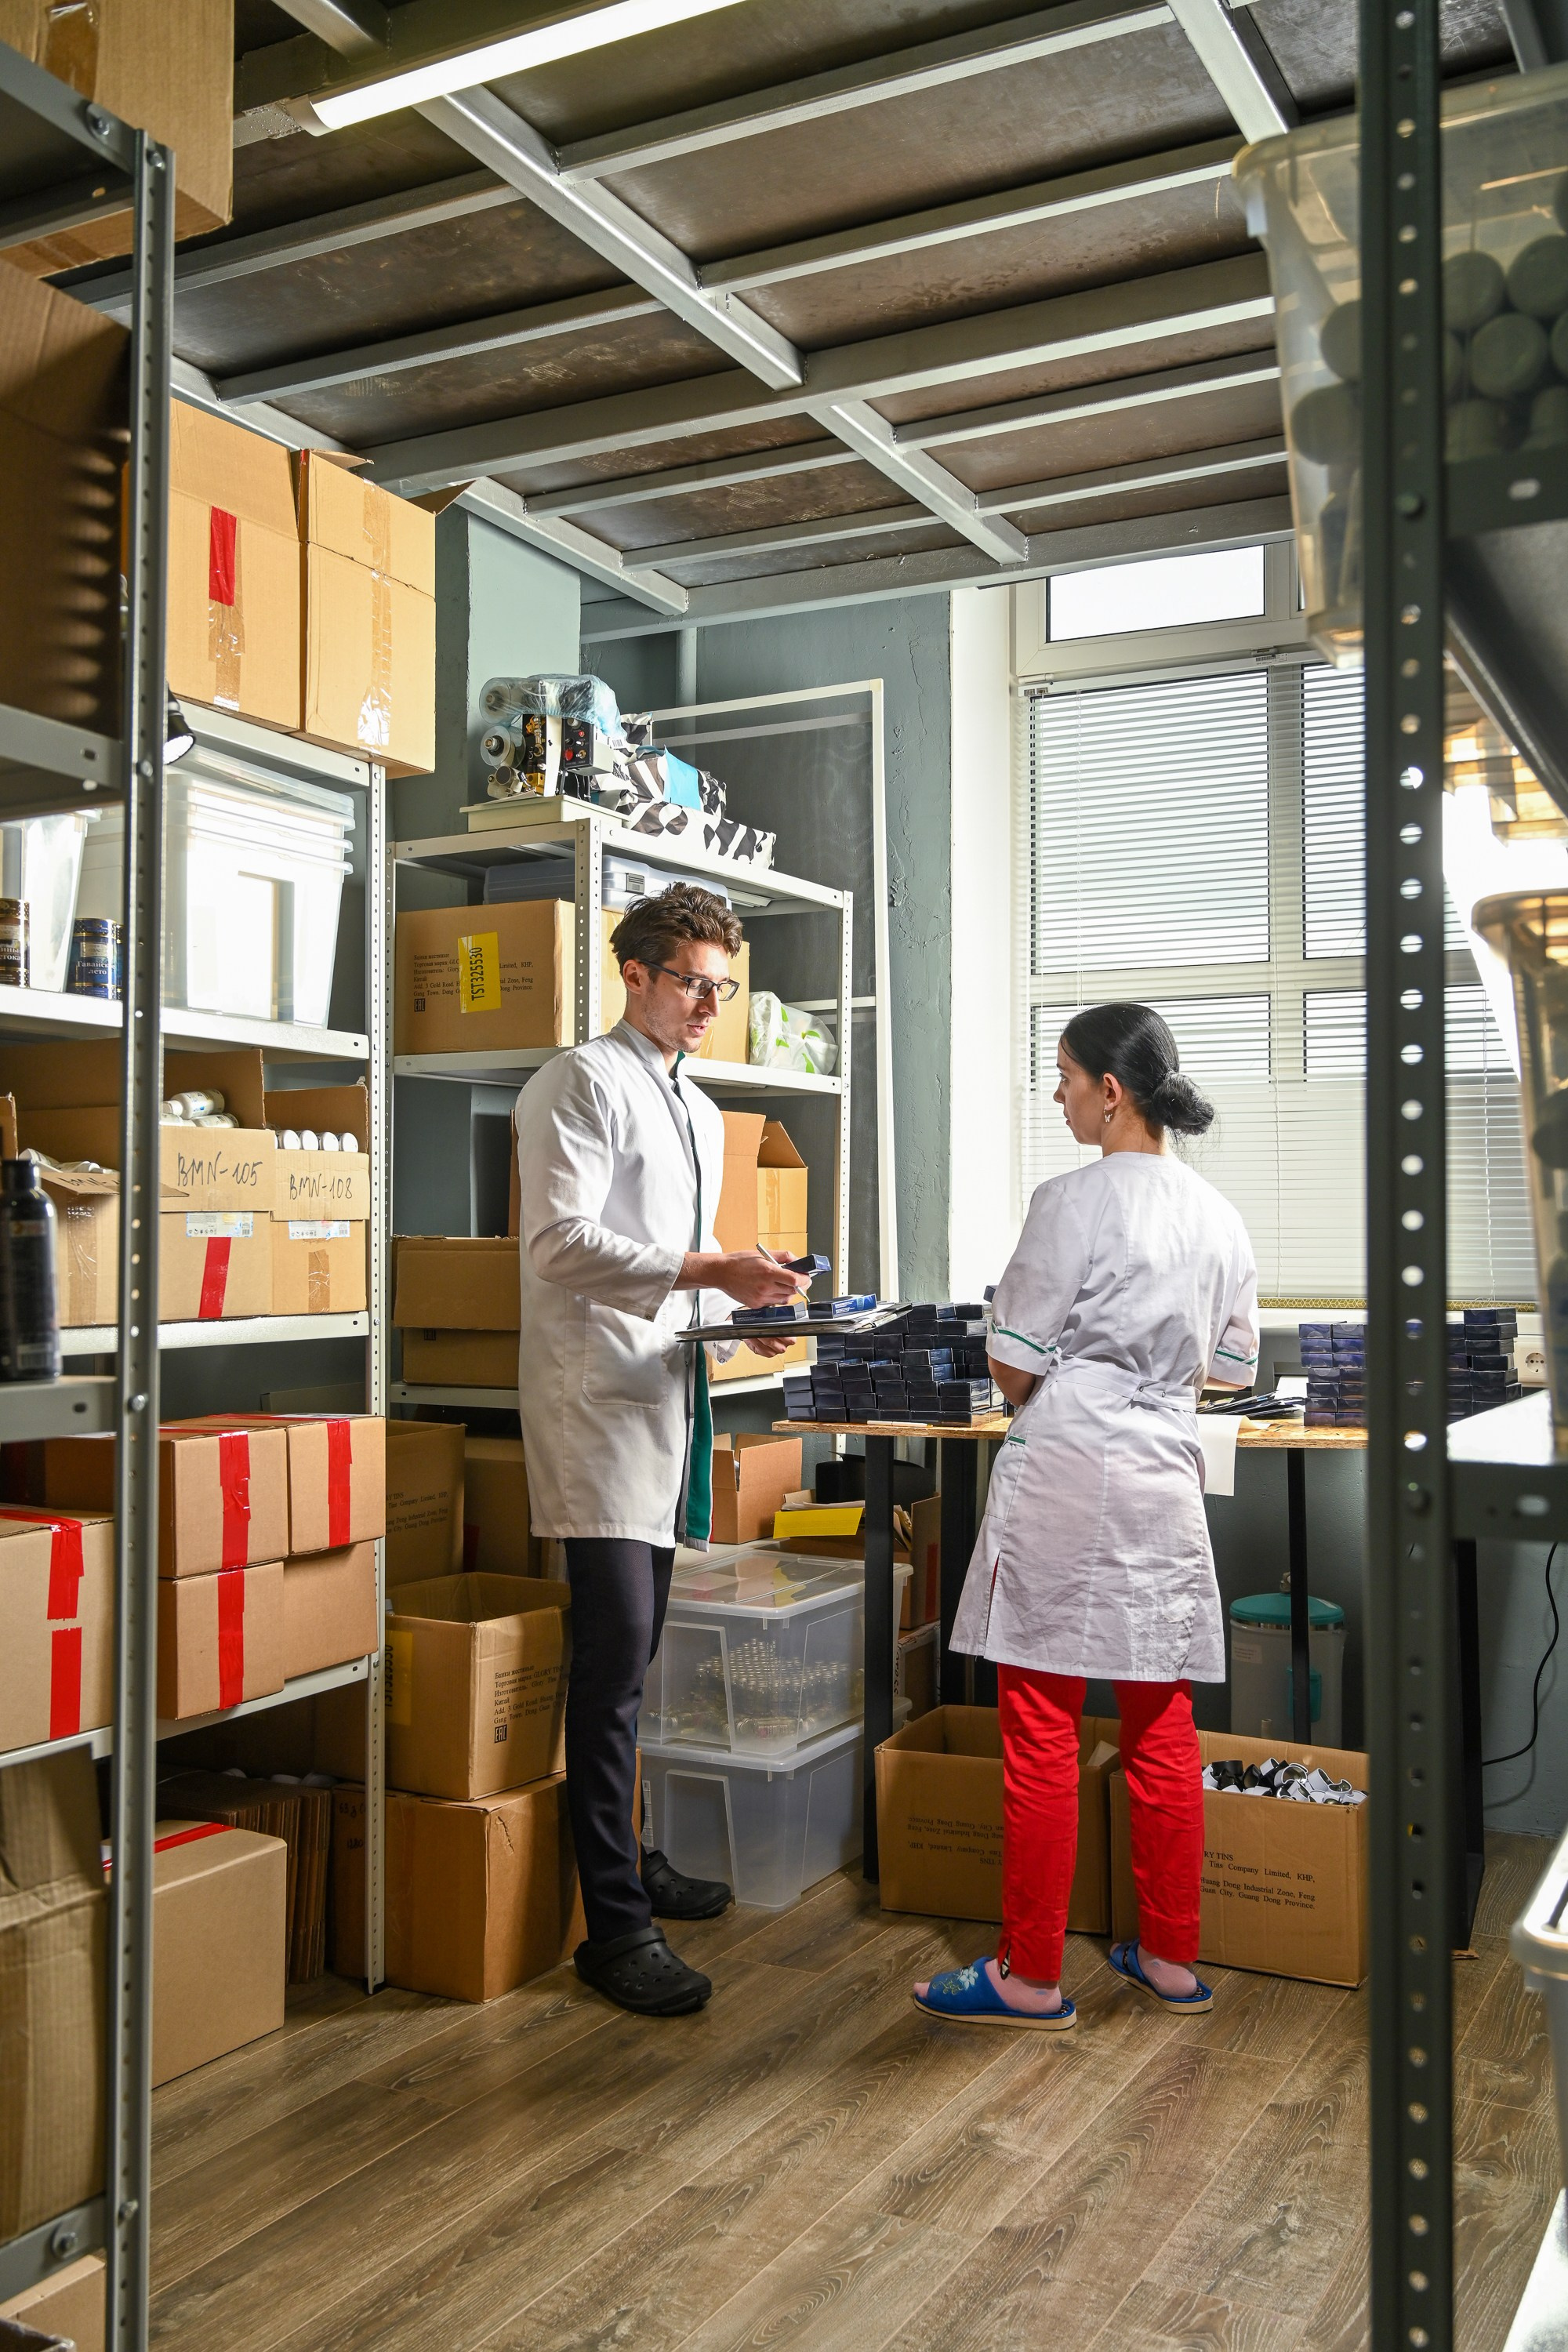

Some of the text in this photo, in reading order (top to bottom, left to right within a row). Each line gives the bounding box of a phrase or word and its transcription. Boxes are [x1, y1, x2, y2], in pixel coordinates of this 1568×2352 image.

[469, 947, 485, 1001] TST325530
[178, 1151, 263, 1187] BMN-105
[289, 1173, 353, 1200] BMN-108
[495, 1671, 510, 1679] Банки
[495, 1680, 517, 1688] Торговая
[534, 1669, 551, 1678] GLORY
[495, 1685, 528, 1697] Изготовитель:
[494, 1697, 510, 1707] Китай
[494, 1707, 506, 1715] Add.
[513, 1702, 524, 1711] Gold
[494, 1716, 507, 1724] Gang
[494, 1724, 507, 1743] EAC
[908, 1824, 922, 1832] Feng
[937, 1819, 952, 1827] Dong
[956, 1821, 975, 1830] Guang
[943, 1829, 969, 1837] Industrial
[973, 1831, 989, 1839] Dong
[957, 1846, 984, 1855] Company
[1217, 1853, 1234, 1861] TINS
[1228, 1863, 1259, 1875] Company
[1264, 1869, 1291, 1879] Limited,
[1223, 1880, 1241, 1890] Dong
[1244, 1883, 1273, 1894] Industrial
[1277, 1888, 1295, 1898] Zone,
[1299, 1892, 1315, 1901] Feng
[1220, 1889, 1234, 1898] City.
[1239, 1892, 1259, 1902] Guang
[1263, 1895, 1281, 1905] Dong
[1285, 1899, 1315, 1910] Province.
